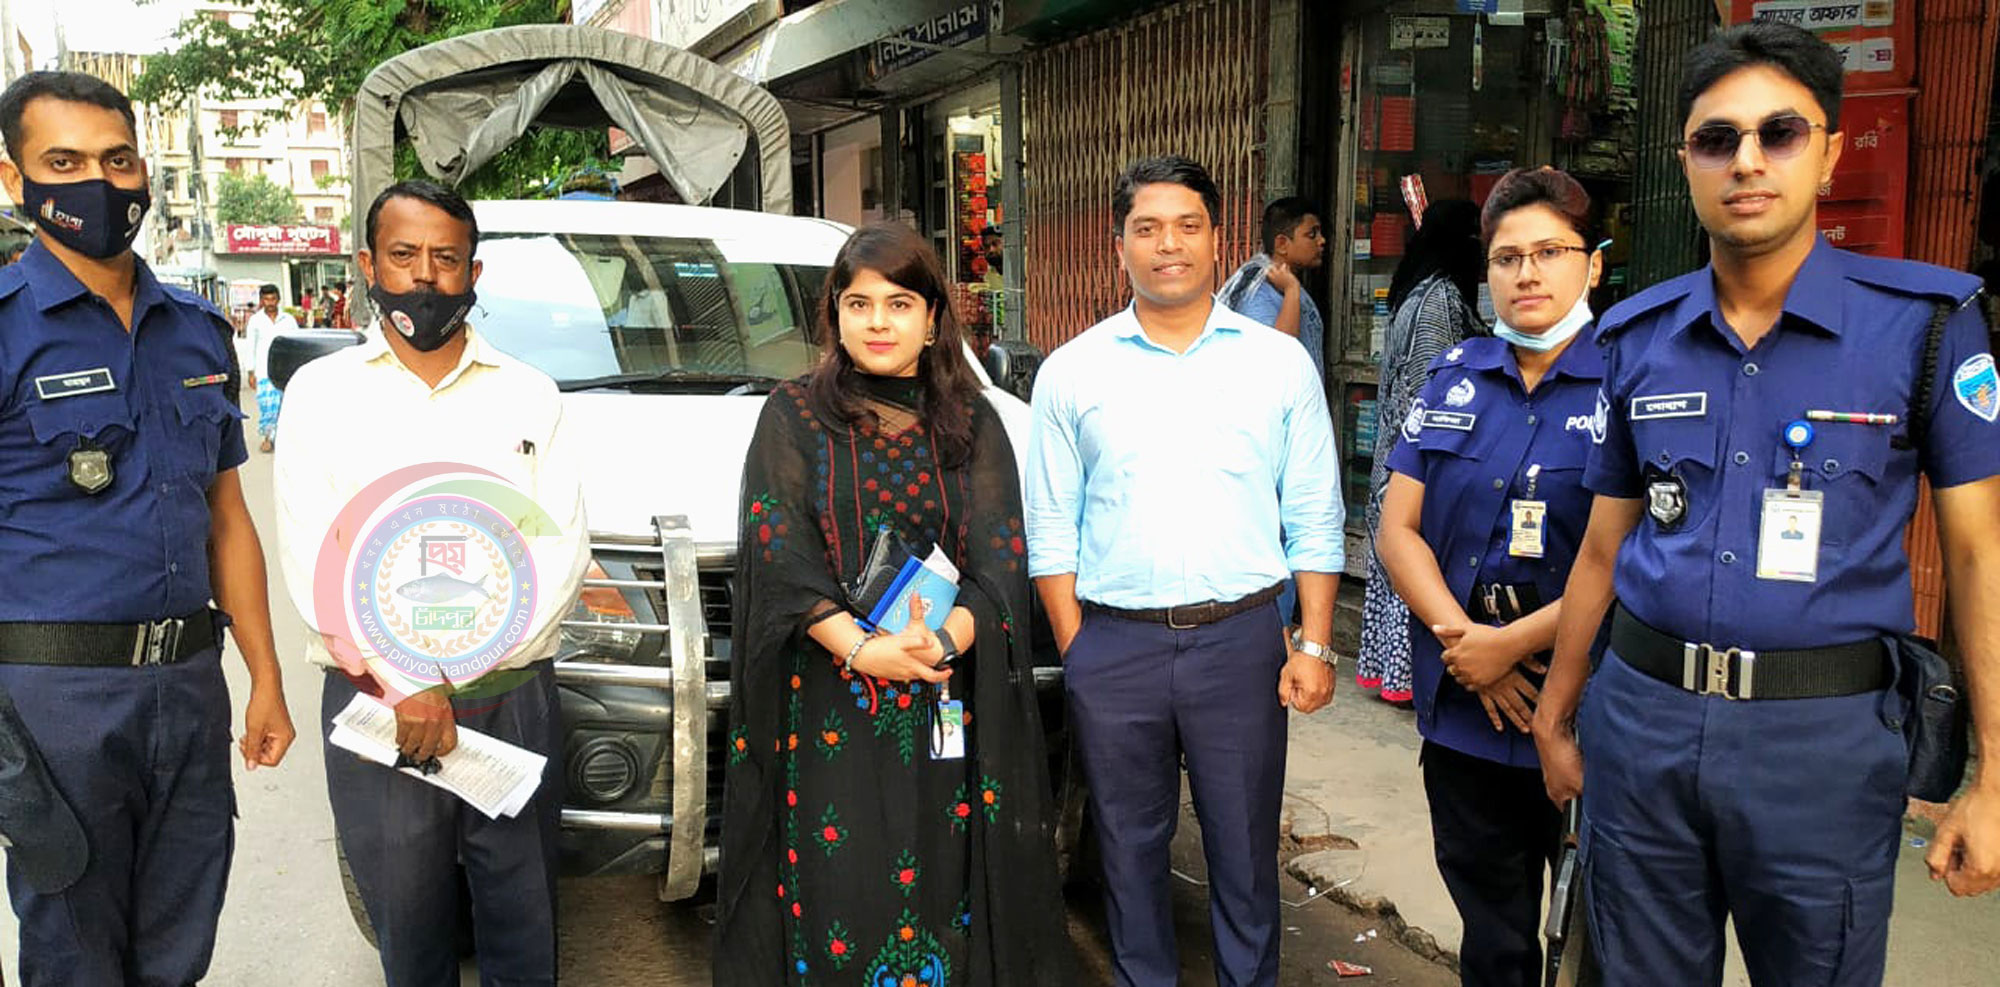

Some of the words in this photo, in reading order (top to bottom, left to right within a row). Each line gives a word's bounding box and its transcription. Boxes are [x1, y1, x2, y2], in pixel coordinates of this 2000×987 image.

[1755, 9, 1805, 26] আমার
[1809, 5, 1861, 21] অফার
[1854, 130, 1878, 150] রবি
